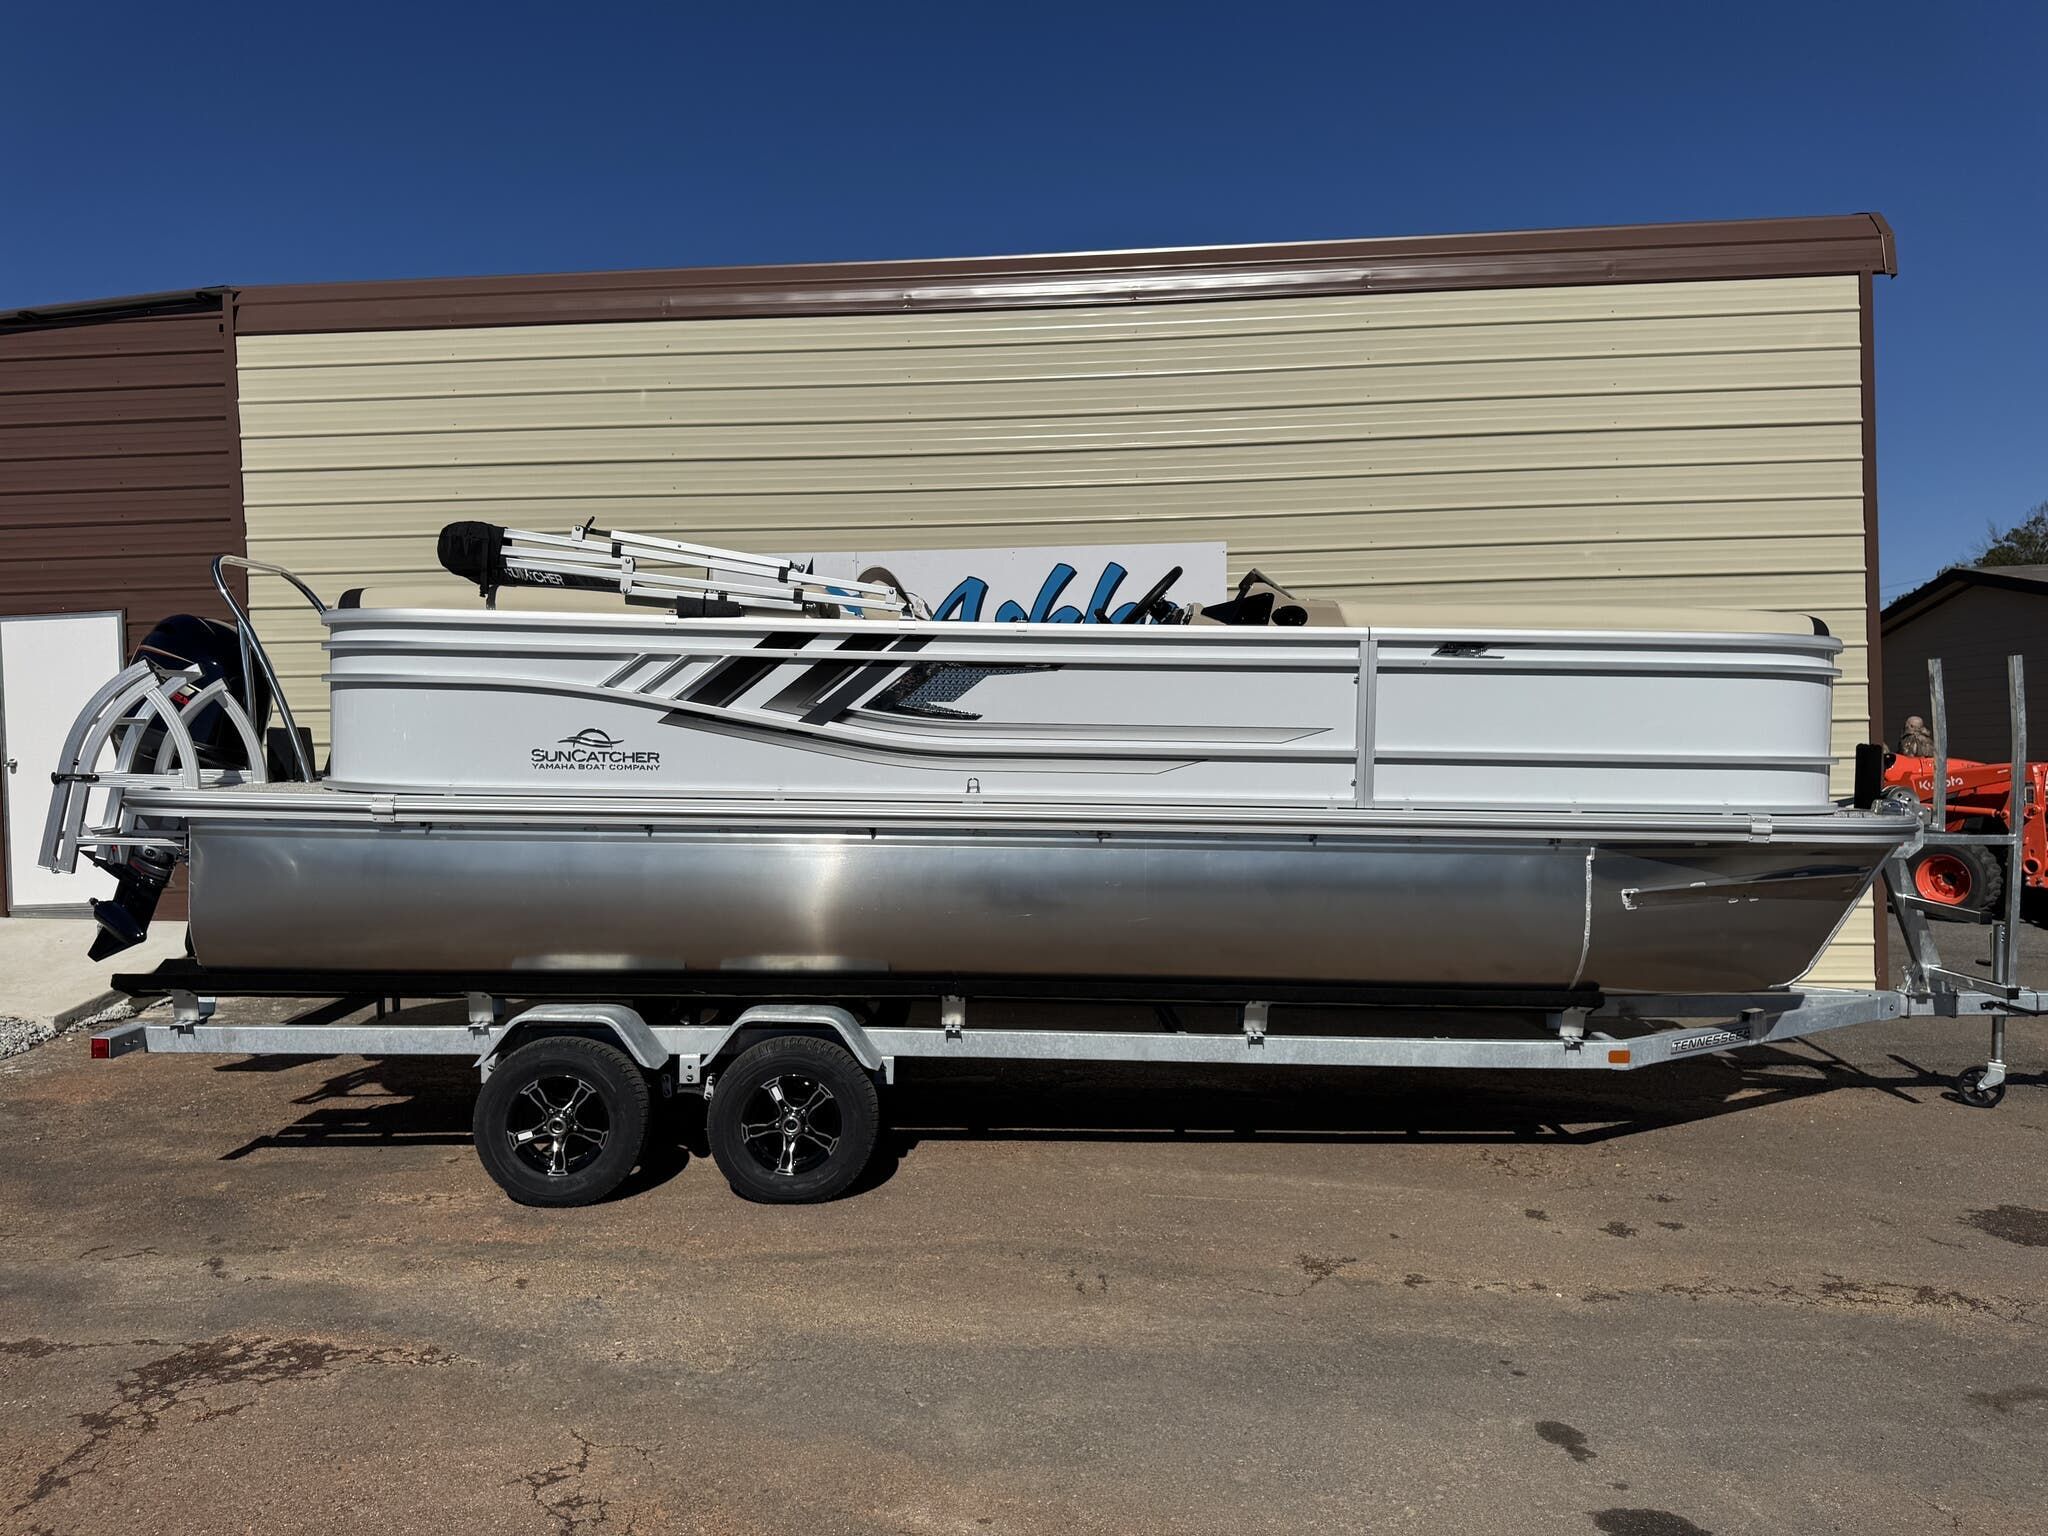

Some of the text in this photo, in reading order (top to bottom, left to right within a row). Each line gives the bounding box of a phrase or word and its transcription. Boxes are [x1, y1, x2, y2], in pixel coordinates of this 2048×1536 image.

[531, 749, 660, 763] SUNCATCHER
[531, 763, 661, 772] YAMAHA BOAT COMPANY
[1919, 776, 1964, 791] Kuota
[1673, 1030, 1743, 1051] TENNESSEE
